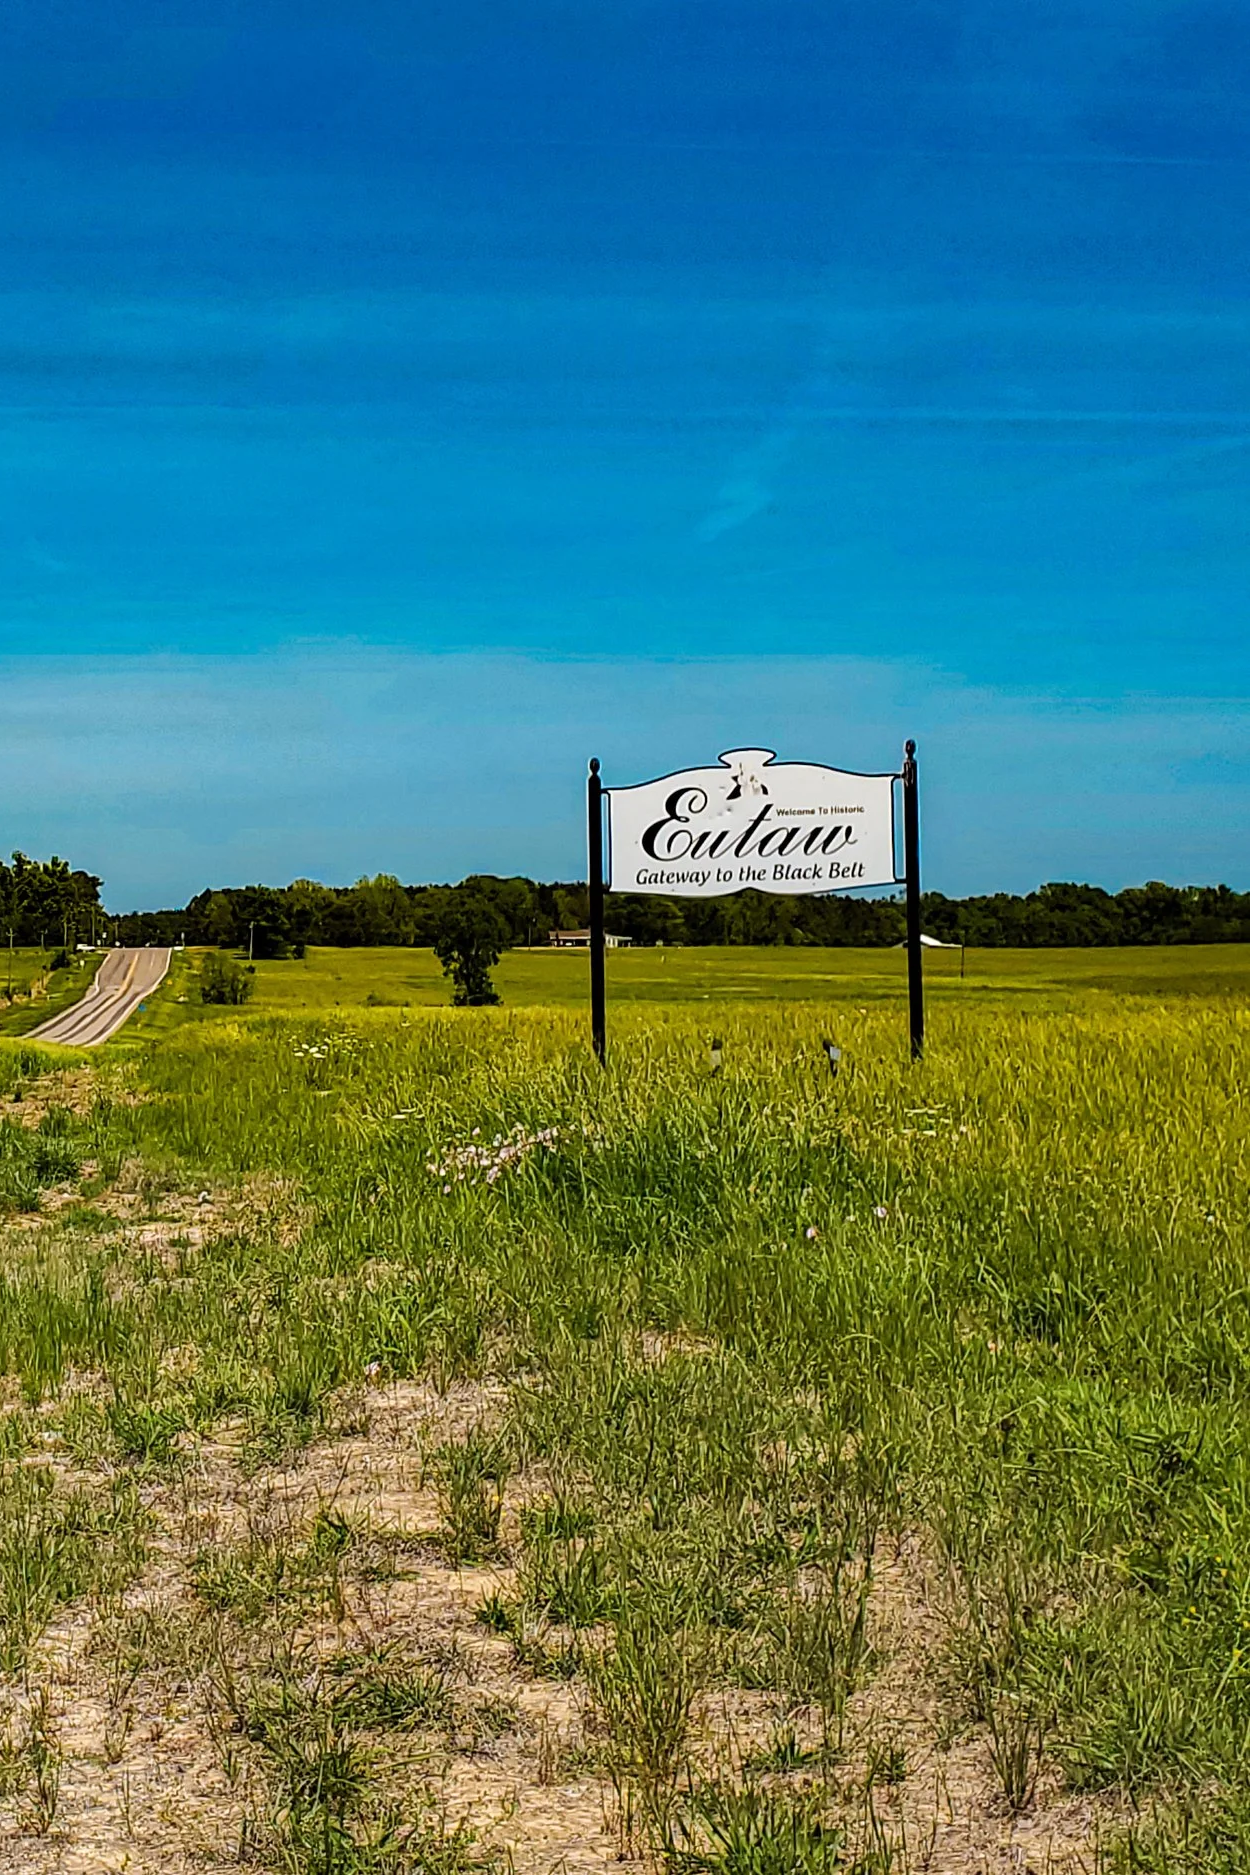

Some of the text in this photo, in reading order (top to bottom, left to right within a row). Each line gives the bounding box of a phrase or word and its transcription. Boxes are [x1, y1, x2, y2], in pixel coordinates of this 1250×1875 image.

[776, 805, 865, 816] Welcome To Historic
[641, 787, 858, 862] Eutaw
[636, 861, 866, 887] Gateway to the Black Belt
